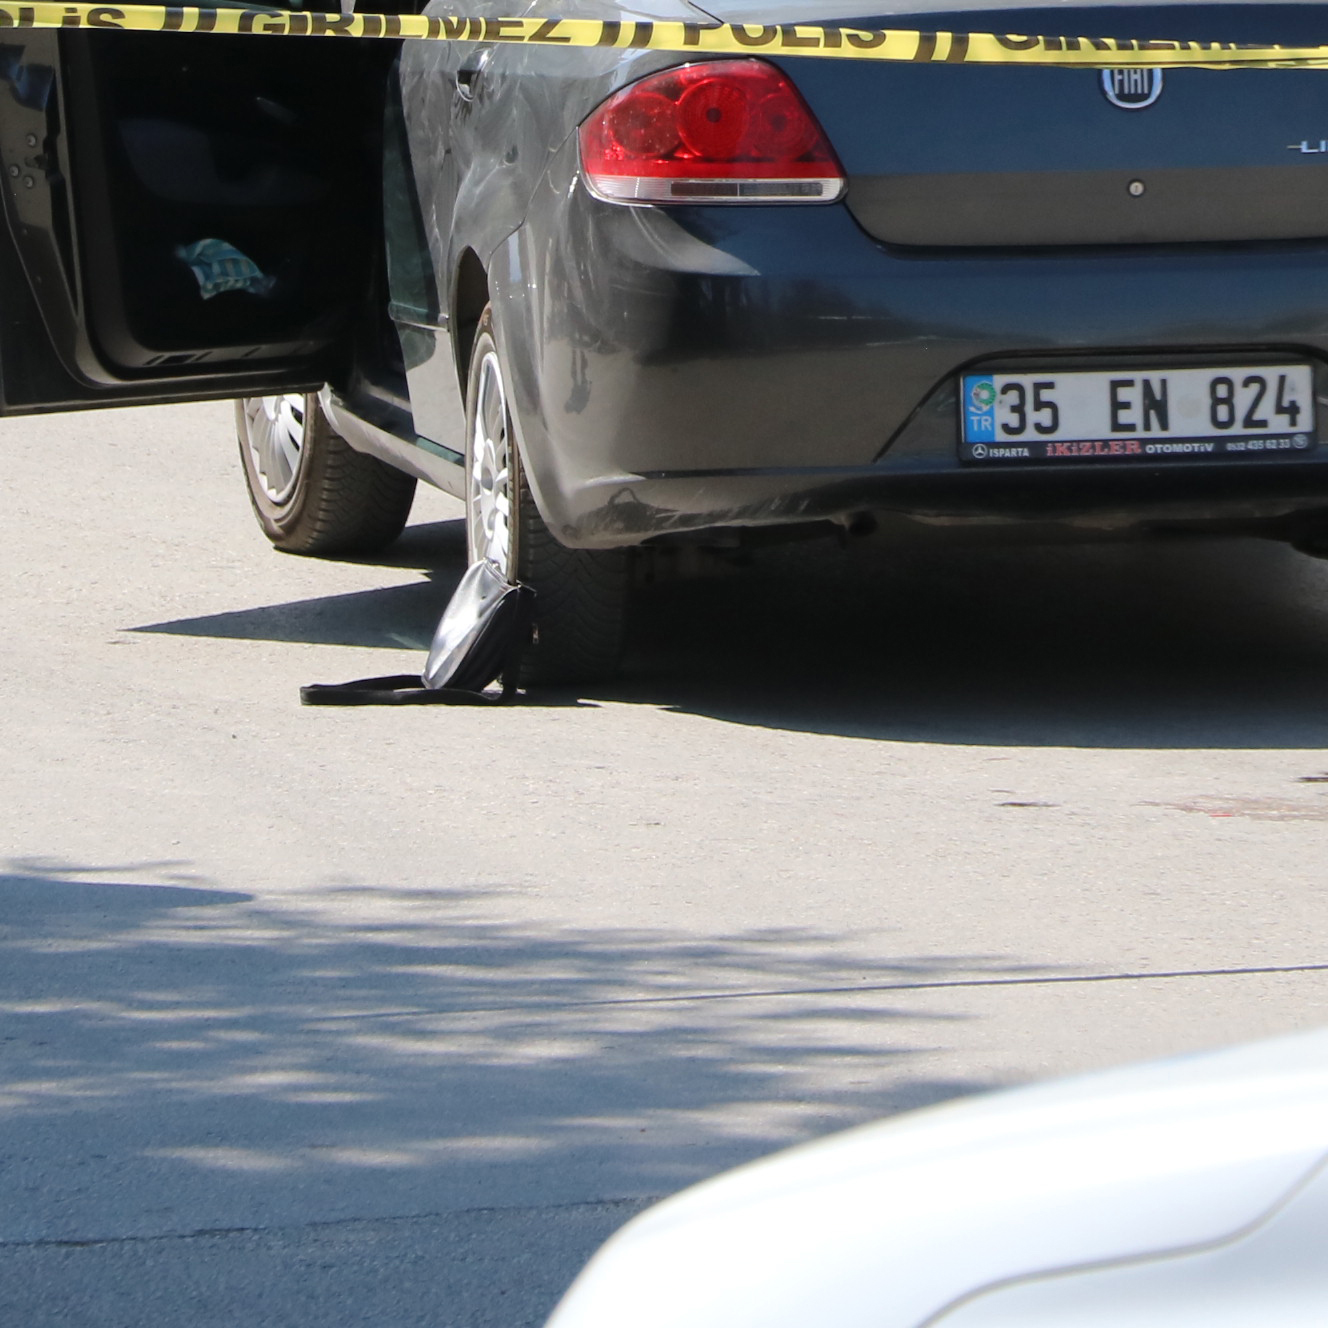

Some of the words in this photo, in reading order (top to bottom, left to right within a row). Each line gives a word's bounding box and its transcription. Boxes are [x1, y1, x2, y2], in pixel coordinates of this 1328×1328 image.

[969, 415, 993, 432] TR
[1000, 381, 1060, 436] 35
[1110, 378, 1169, 434] EN
[1209, 374, 1301, 430] 824
[989, 447, 1030, 458] ISPARTA
